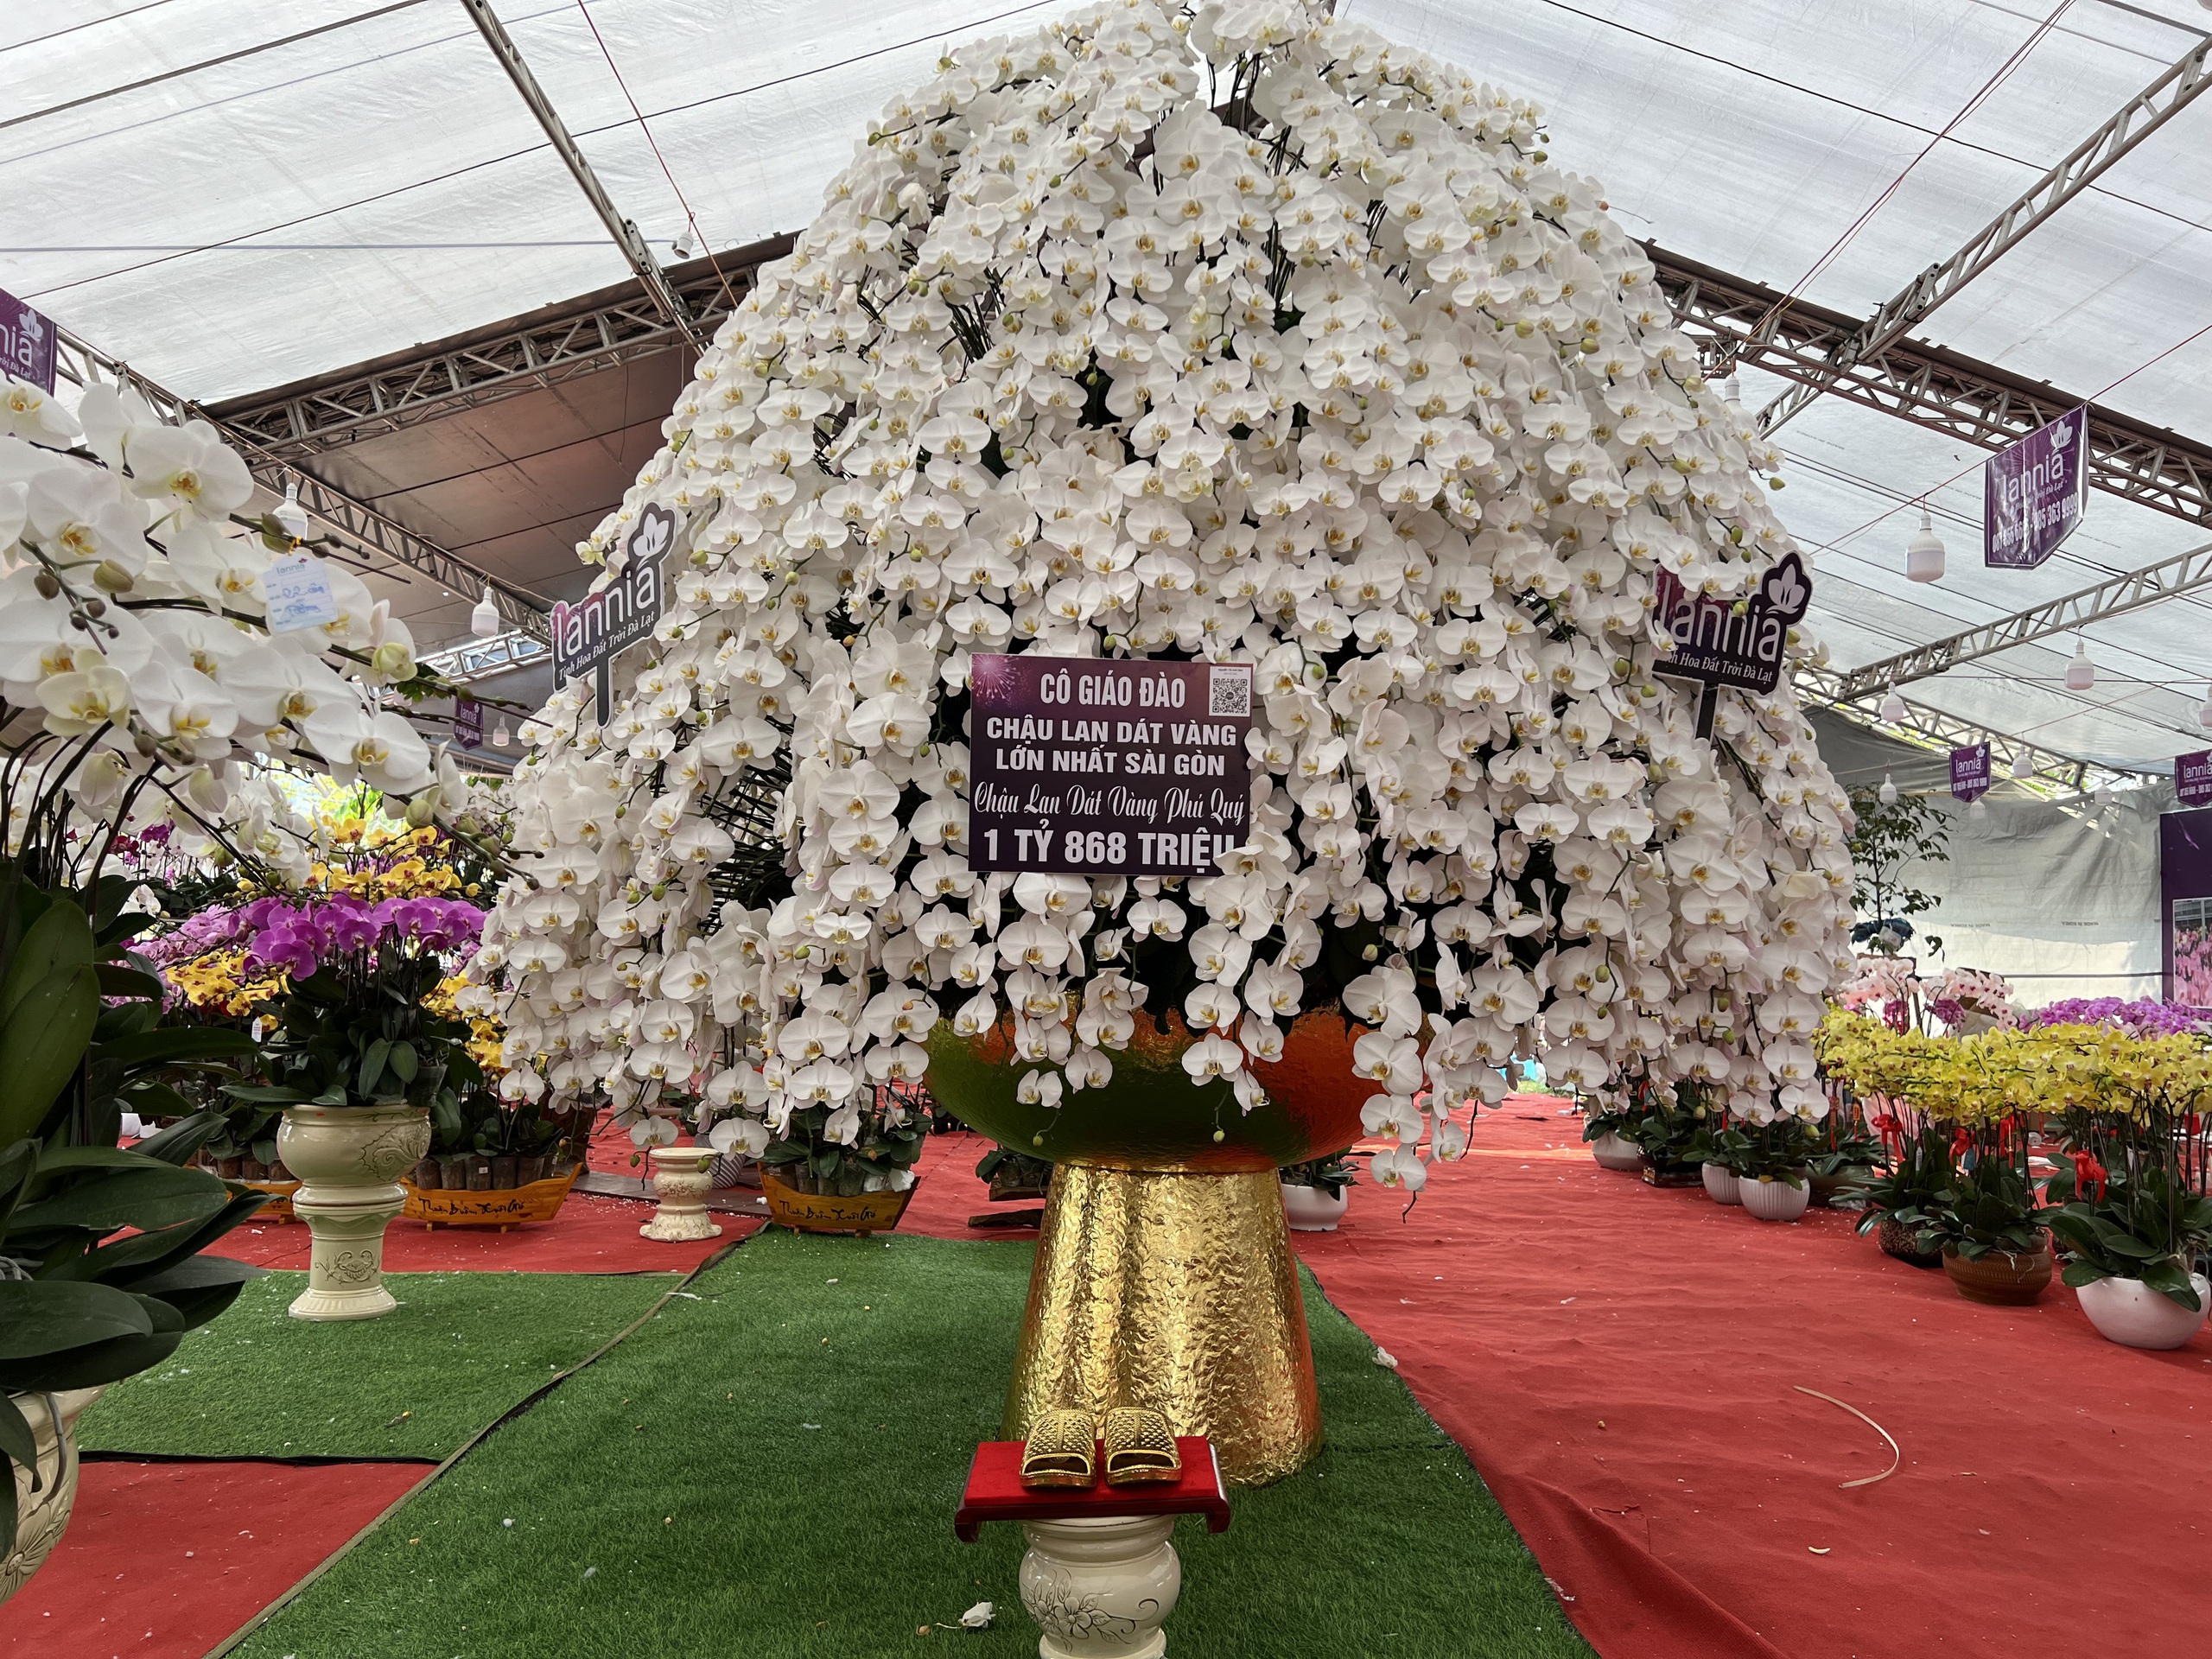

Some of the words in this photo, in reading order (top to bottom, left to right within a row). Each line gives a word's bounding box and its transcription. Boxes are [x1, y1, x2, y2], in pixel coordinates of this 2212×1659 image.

[2003, 454, 2064, 509] lannia
[2048, 500, 2061, 525] 363
[2062, 492, 2078, 519] 9999
[276, 563, 306, 575] lannia
[556, 567, 656, 664] lannia
[1660, 575, 1781, 663] lannia
[575, 652, 592, 671] Hoa
[593, 639, 607, 658] Đất
[608, 626, 626, 648] Trời
[627, 619, 639, 637] Đà
[640, 610, 655, 629] Lạt
[1039, 667, 1071, 704] CÔ
[1078, 670, 1132, 706] GIÁO
[1139, 671, 1186, 709] ĐÀO
[1679, 652, 1700, 669] Hoa
[1701, 656, 1720, 673] Đất
[1721, 660, 1743, 677] Trời
[1743, 663, 1757, 680] Đà
[1757, 668, 1774, 685] Lạt
[986, 714, 1053, 745] CHẬU
[1060, 719, 1109, 742] LAN
[1116, 717, 1164, 744] DÁT
[1170, 719, 1237, 747] VÀNG
[996, 744, 1045, 771] LỚN
[1052, 744, 1118, 773] NHẤT
[1125, 748, 1166, 775] SÀI
[1173, 749, 1225, 776] GÒN
[1955, 758, 1981, 773] lannia
[974, 781, 1020, 819] Chậu
[1024, 783, 1061, 821] Lan
[1066, 784, 1103, 816] Dát
[1107, 785, 1158, 824] Vàng
[1164, 786, 1205, 824] Phú
[1210, 787, 1245, 826] Quý
[983, 829, 998, 861] 1
[1014, 818, 1054, 862] TỶ
[1065, 831, 1127, 865] 868
